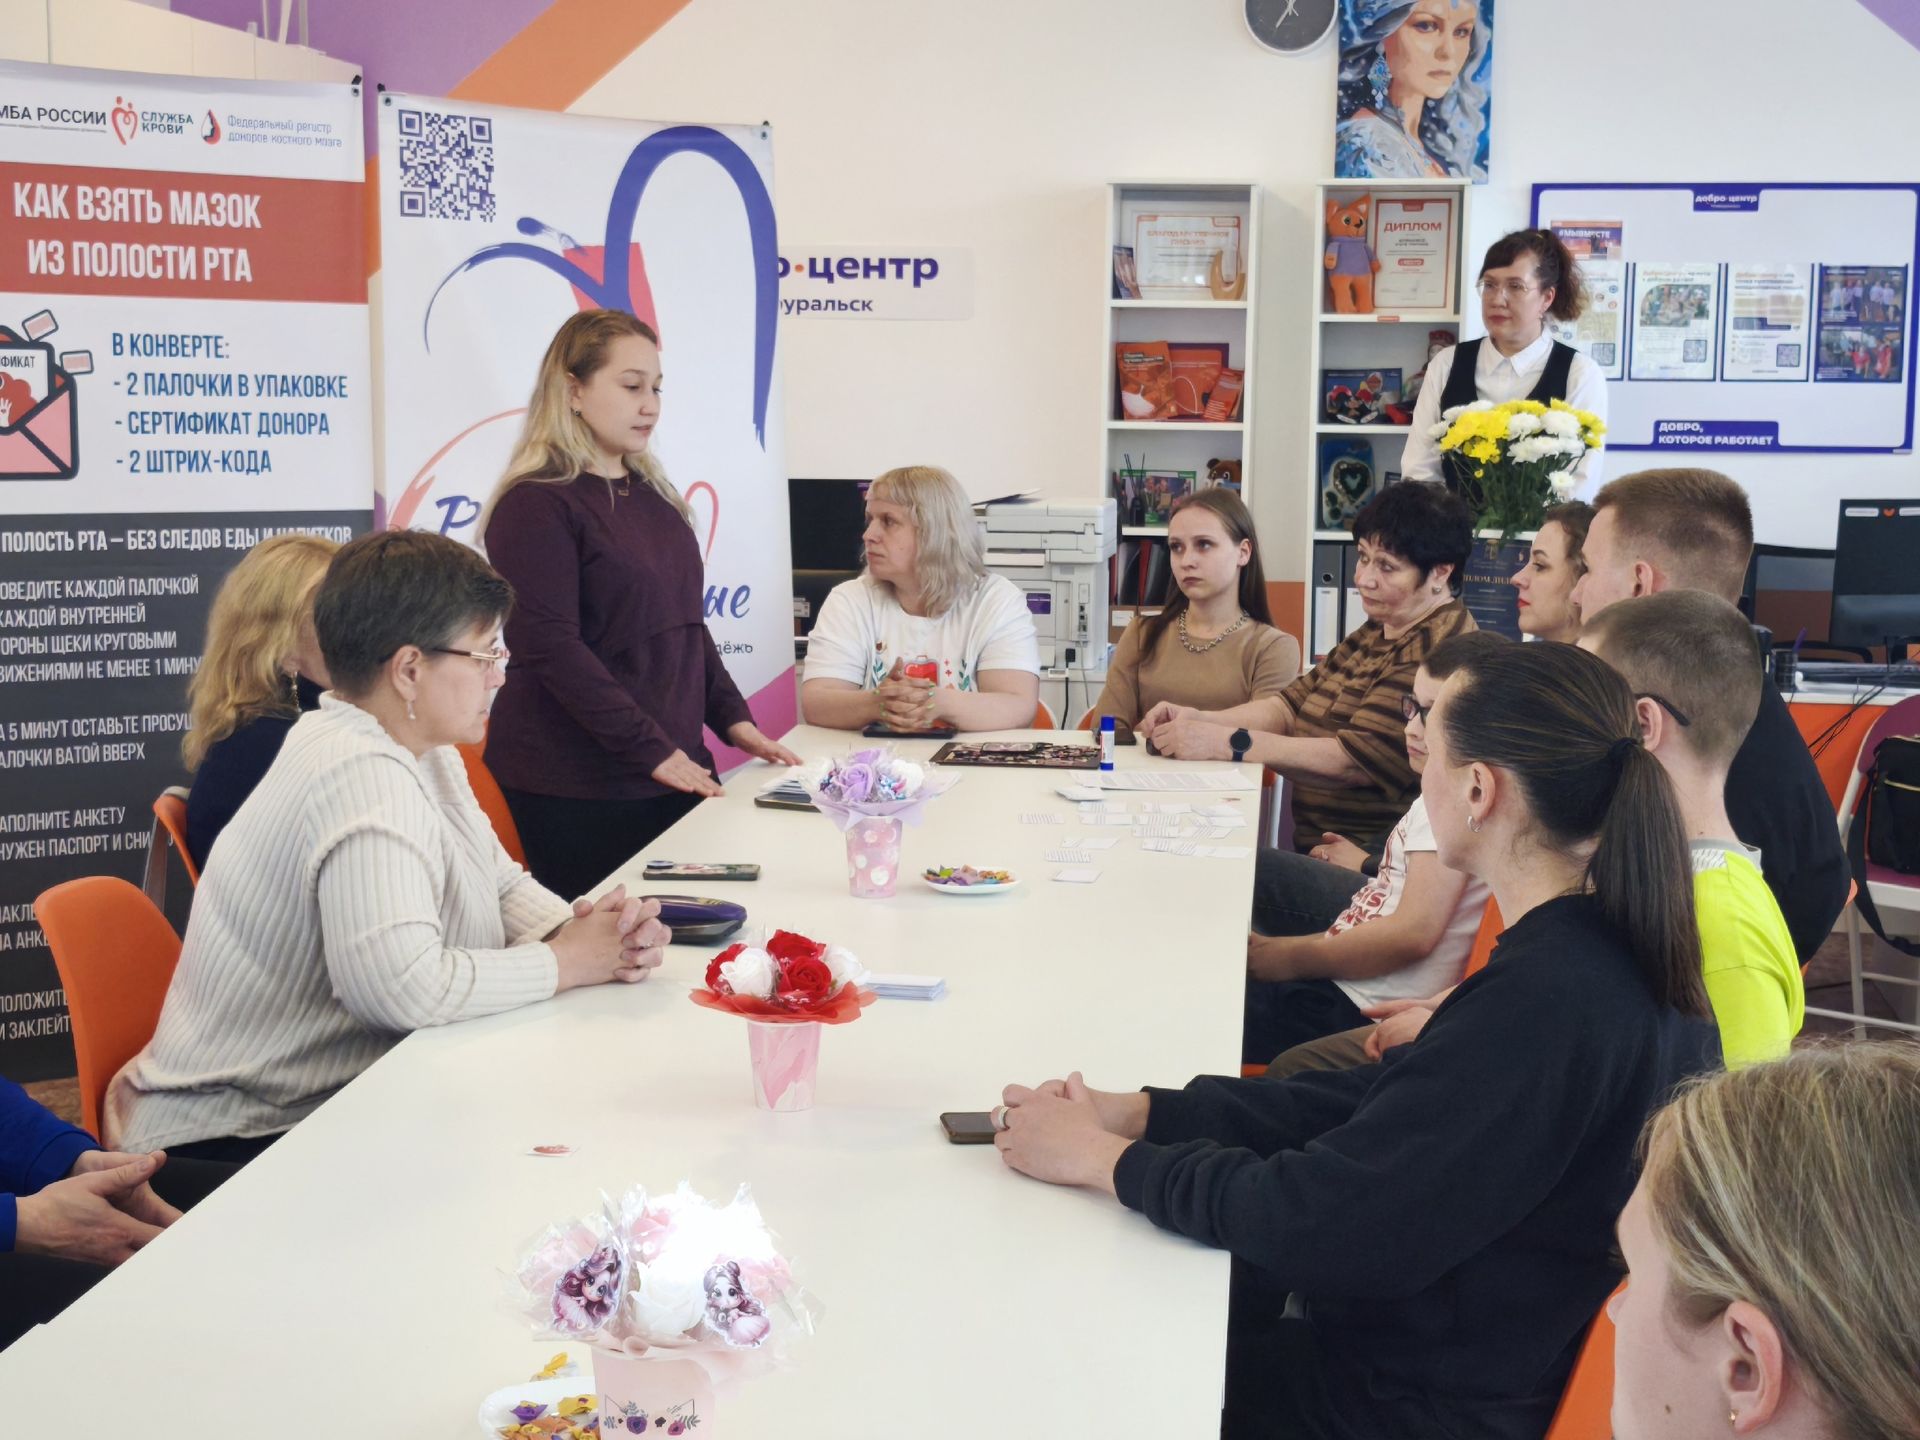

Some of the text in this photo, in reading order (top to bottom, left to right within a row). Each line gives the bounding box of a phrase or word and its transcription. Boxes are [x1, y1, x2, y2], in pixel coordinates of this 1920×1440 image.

[37, 107, 107, 125] РОССИИ
[141, 111, 194, 124] СЛУЖБА
[142, 122, 183, 134] КРОВИ
[227, 115, 333, 135] Федеральный регистр
[13, 182, 262, 229] КАК ВЗЯТЬ МАЗОК
[1383, 221, 1443, 233] ДИПЛОМ
[27, 239, 253, 282] ИЗ ПОЛОСТИ РТА
[780, 298, 873, 316] уральск
[112, 332, 230, 359] В КОНВЕРТЕ:
[127, 372, 139, 396] 2
[144, 372, 233, 397] ПАЛОЧКИ
[238, 374, 250, 397] В
[254, 374, 349, 398] УПАКОВКЕ
[127, 411, 252, 435] СЕРТИФИКАТ
[257, 412, 330, 438] ДОНОРА
[1658, 422, 1704, 433] ДОБРО,
[1658, 435, 1774, 446] КОТОРОЕ РАБОТАЕТ
[129, 450, 141, 474] 2
[146, 450, 273, 476] ШТРИХ-КОДА
[1, 530, 75, 553] ПОЛОСТЬ
[77, 530, 108, 552] РТА
[127, 528, 157, 551] БЕЗ
[160, 527, 222, 551] СЛЕДОВ
[225, 527, 259, 550] ЕДЫ
[65, 576, 126, 600] КАЖДОЙ
[128, 573, 199, 597] ПАЛОЧКОЙ
[60, 602, 146, 626] ВНУТРЕННЕЙ
[51, 633, 92, 655] ЩЕКИ
[94, 631, 177, 652] КРУГОВЫМИ
[86, 660, 104, 679] НЕ
[107, 658, 151, 678] МЕНЕЕ
[155, 658, 162, 675] 1
[9, 722, 18, 741] 5
[21, 719, 69, 740] МИНУТ
[71, 716, 139, 738] ОСТАВЬТЕ
[55, 742, 100, 766] ВАТОЙ
[103, 742, 146, 762] ВВЕРХ
[73, 807, 126, 828] АНКЕТУ
[48, 834, 109, 857] ПАСПОРТ
[112, 833, 122, 851] И
[125, 831, 152, 850] СНИ
